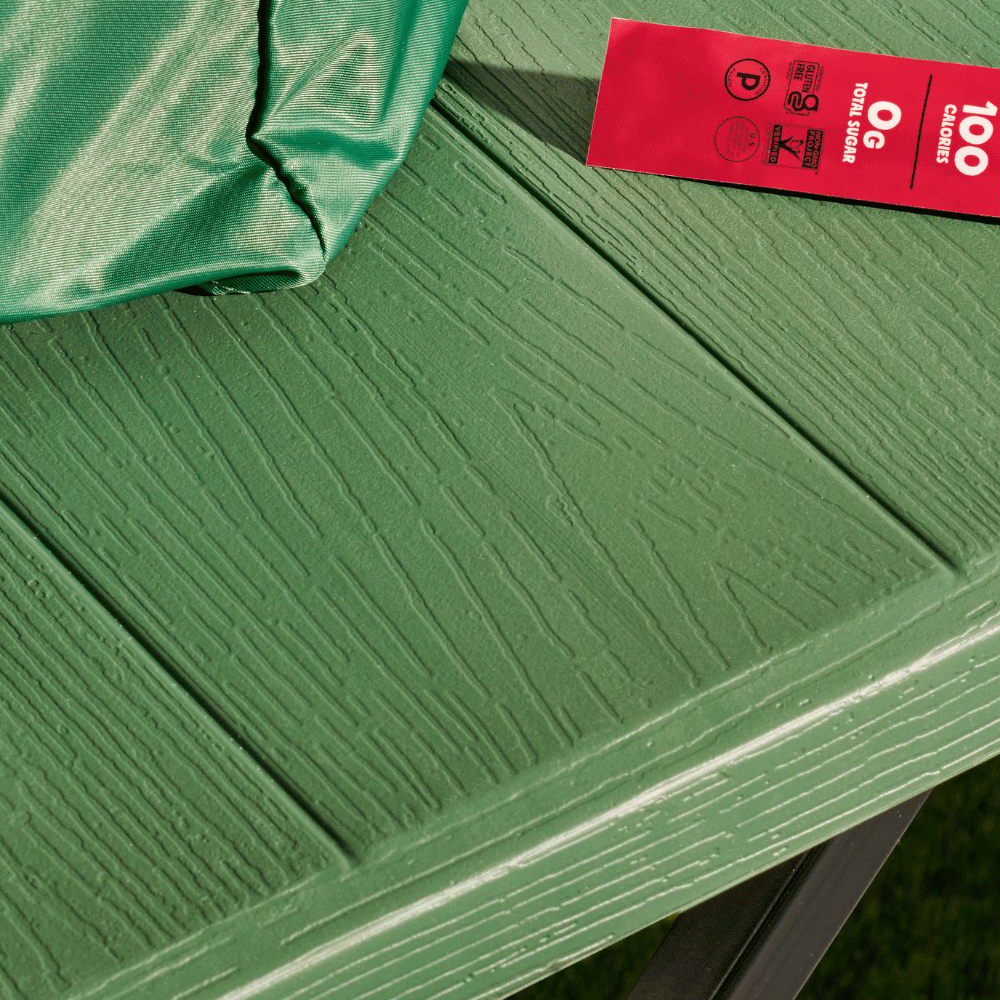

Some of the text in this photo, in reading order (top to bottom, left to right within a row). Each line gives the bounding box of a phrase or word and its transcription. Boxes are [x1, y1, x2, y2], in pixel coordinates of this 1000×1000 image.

[736, 72, 761, 91] P
[794, 62, 805, 80] FREE
[801, 64, 815, 93] GLUTEN
[843, 83, 868, 163] TOTAL SUGAR
[936, 104, 957, 163] CALORIES
[955, 101, 997, 176] 100
[770, 126, 782, 163] VERIFIED
[804, 131, 815, 167] PROJECT
[811, 131, 822, 167] NON-GMO
